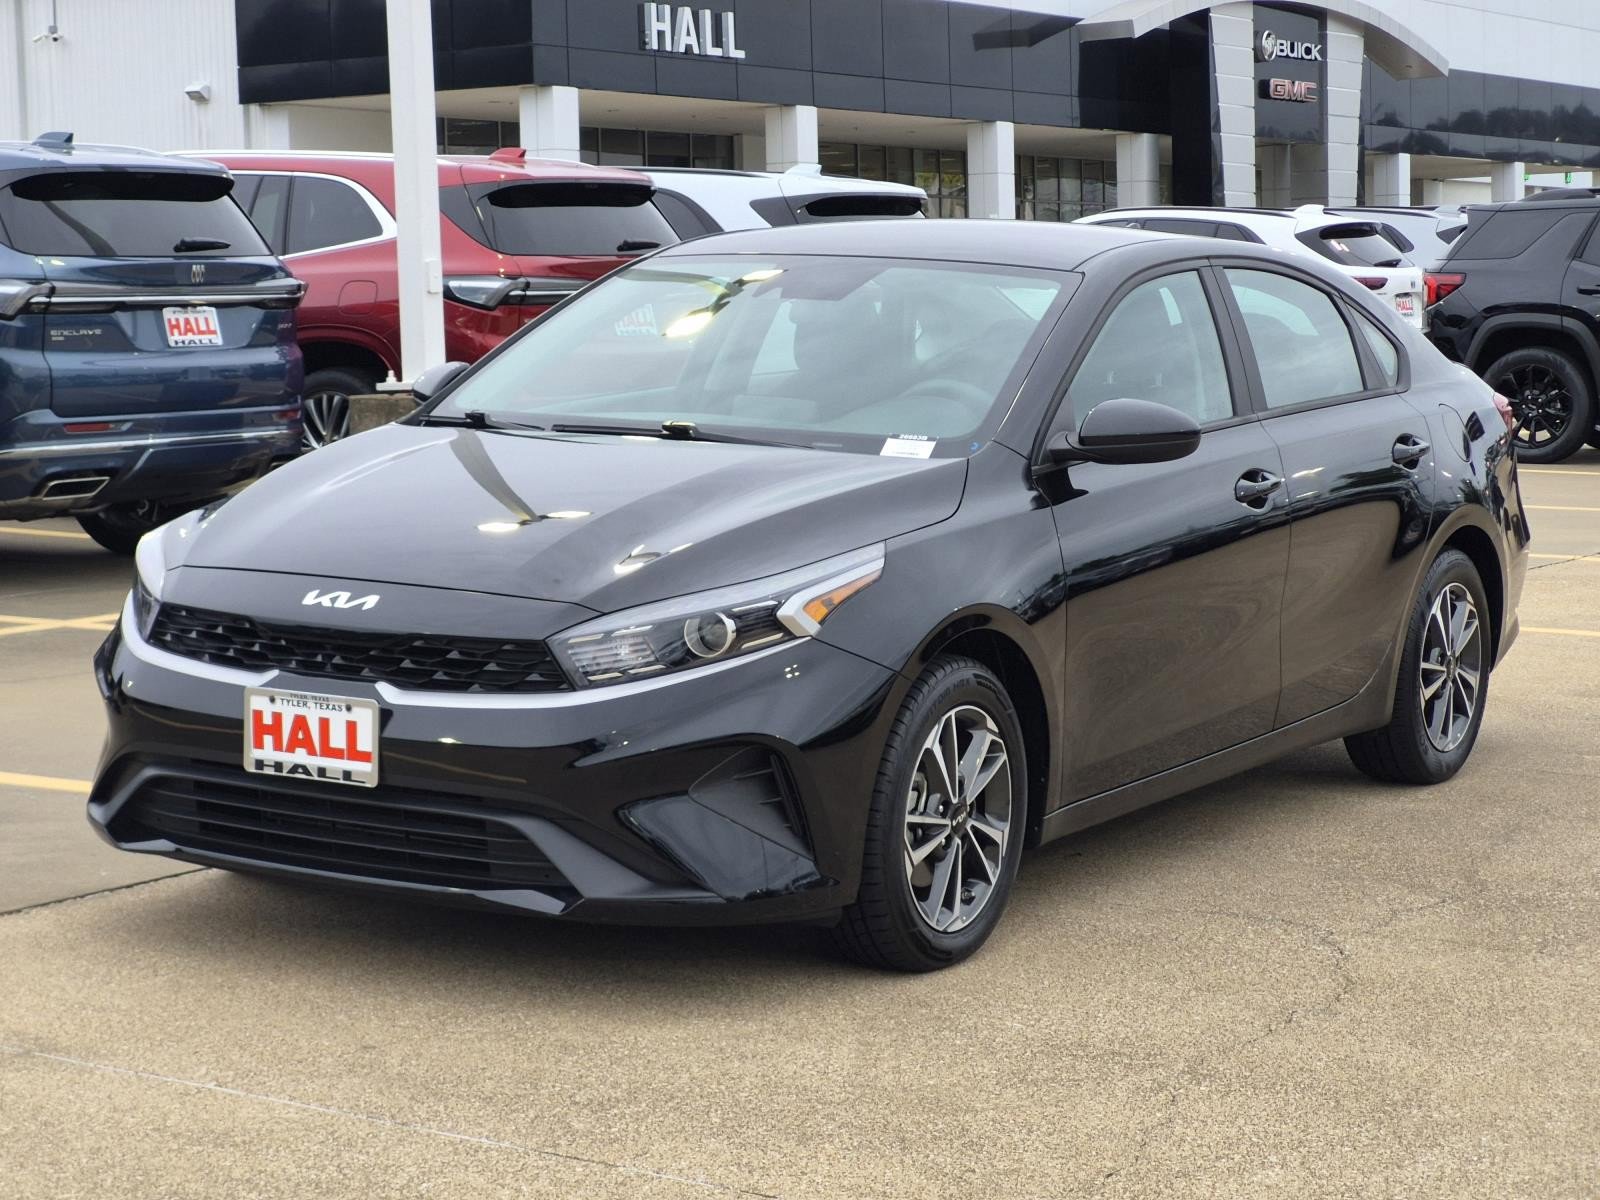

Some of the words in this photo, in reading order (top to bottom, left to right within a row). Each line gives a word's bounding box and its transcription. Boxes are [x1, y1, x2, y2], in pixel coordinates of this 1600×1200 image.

[643, 2, 746, 59] HALL
[1276, 39, 1323, 61] BUICK
[1269, 78, 1318, 102] GMC
[167, 316, 218, 336] HALL
[173, 338, 219, 346] HALL
[301, 589, 380, 611] KIA
[280, 698, 311, 710] TYLER,
[314, 702, 343, 712] TEXAS
[252, 709, 373, 763] HALL
[254, 759, 367, 784] HALL
